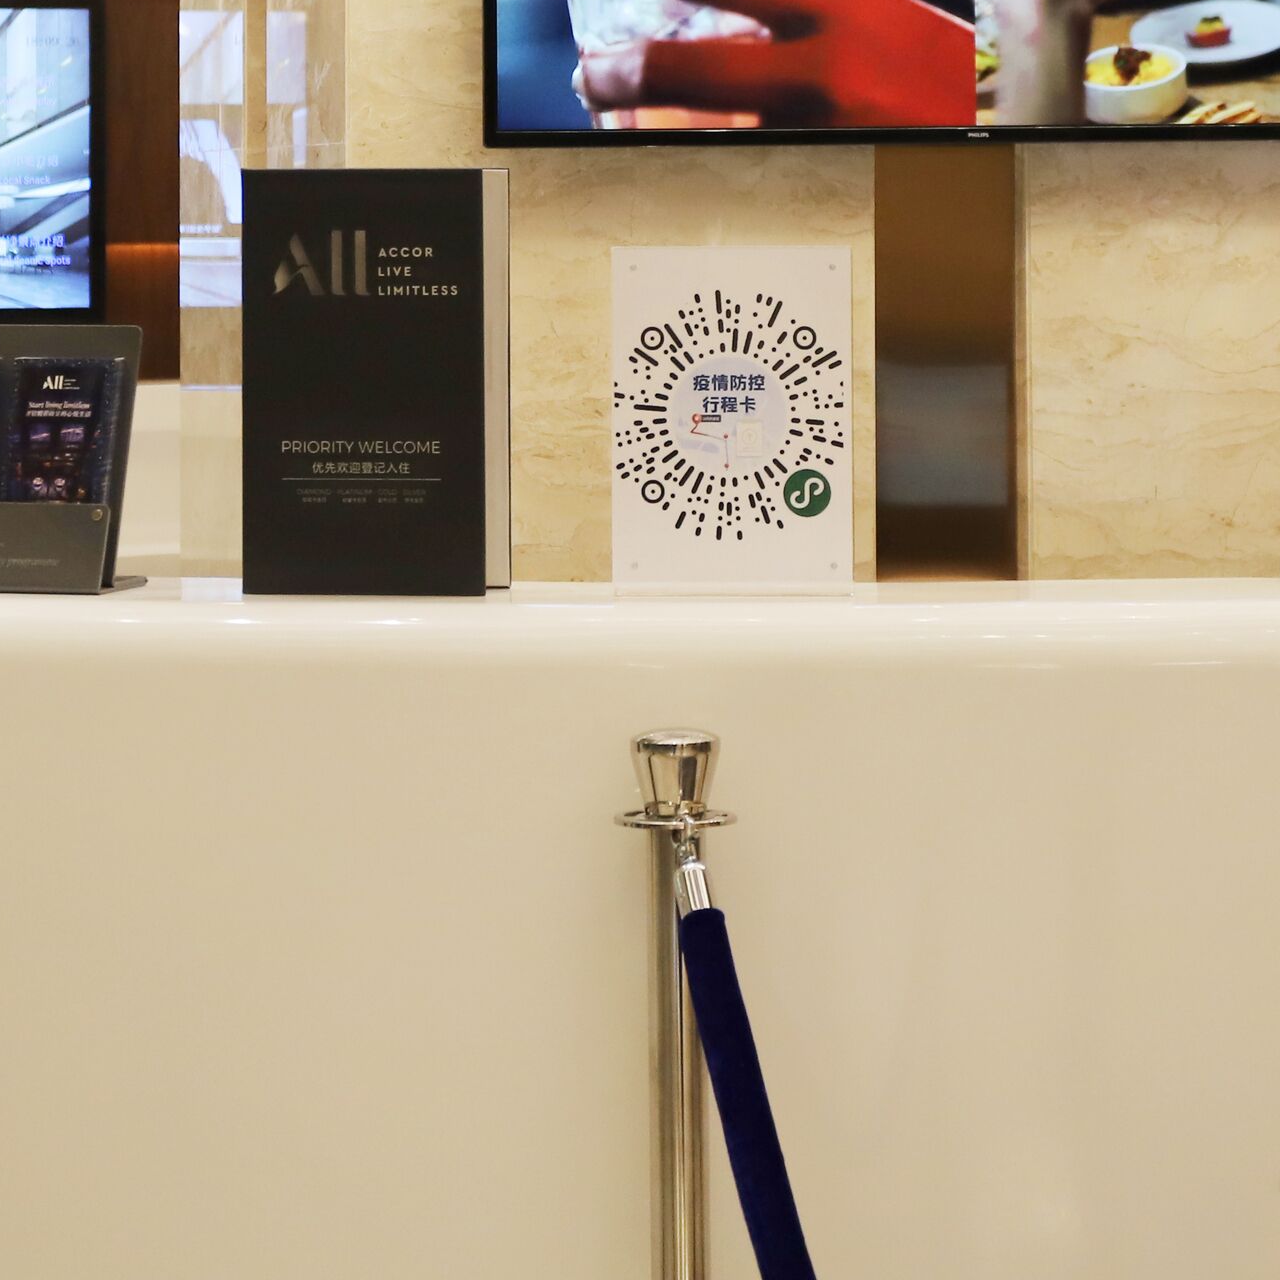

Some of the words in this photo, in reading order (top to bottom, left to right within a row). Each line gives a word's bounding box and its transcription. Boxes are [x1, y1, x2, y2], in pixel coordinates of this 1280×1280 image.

[23, 175, 51, 185] Snack
[378, 247, 434, 258] ACCOR
[377, 266, 413, 277] LIVE
[377, 285, 459, 296] LIMITLESS
[693, 374, 766, 391] 疫情防控
[702, 395, 757, 414] 行程卡
[280, 440, 355, 454] PRIORITY
[358, 440, 441, 454] WELCOME
[312, 461, 411, 475] 优先欢迎登记入住
